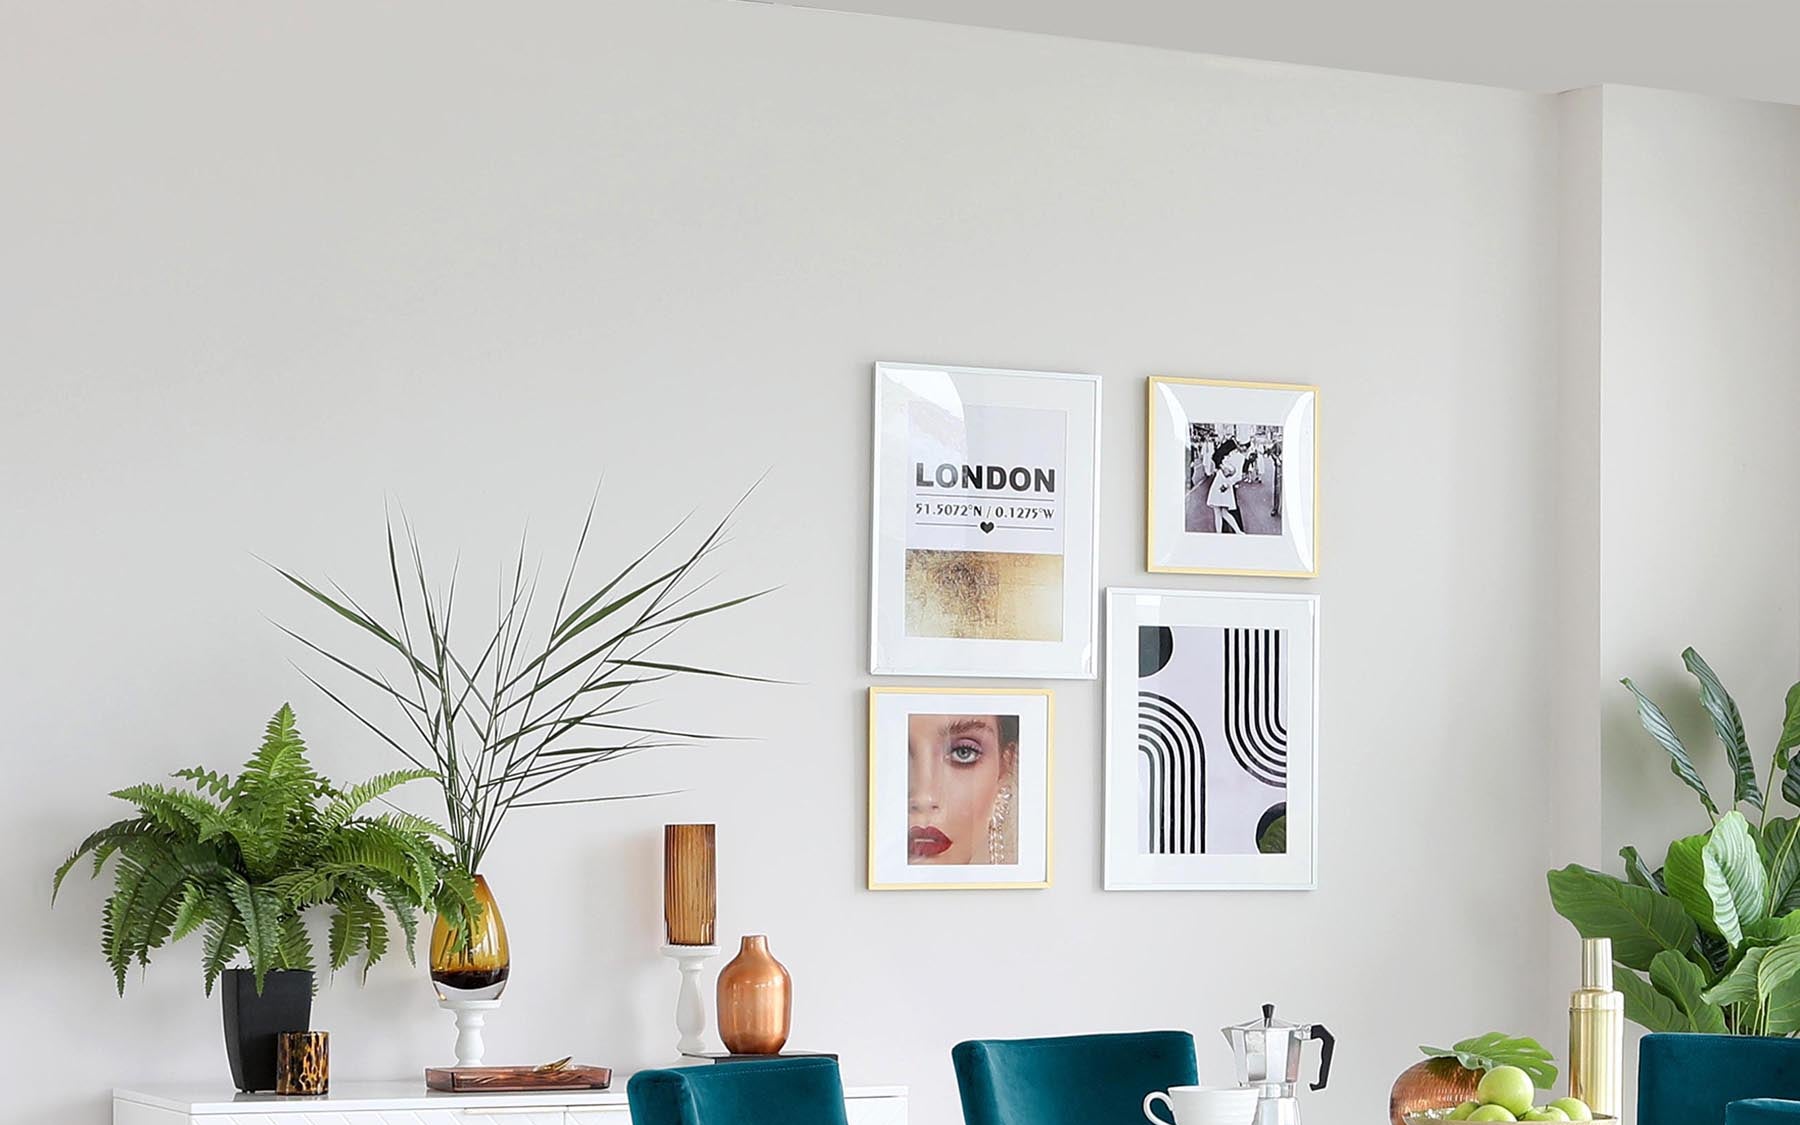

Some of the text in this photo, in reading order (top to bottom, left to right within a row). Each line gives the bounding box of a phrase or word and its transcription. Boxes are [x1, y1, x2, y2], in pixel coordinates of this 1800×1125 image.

[916, 462, 1056, 493] LONDON
[915, 503, 1055, 520] 51.5072°N / 0.1275°W
